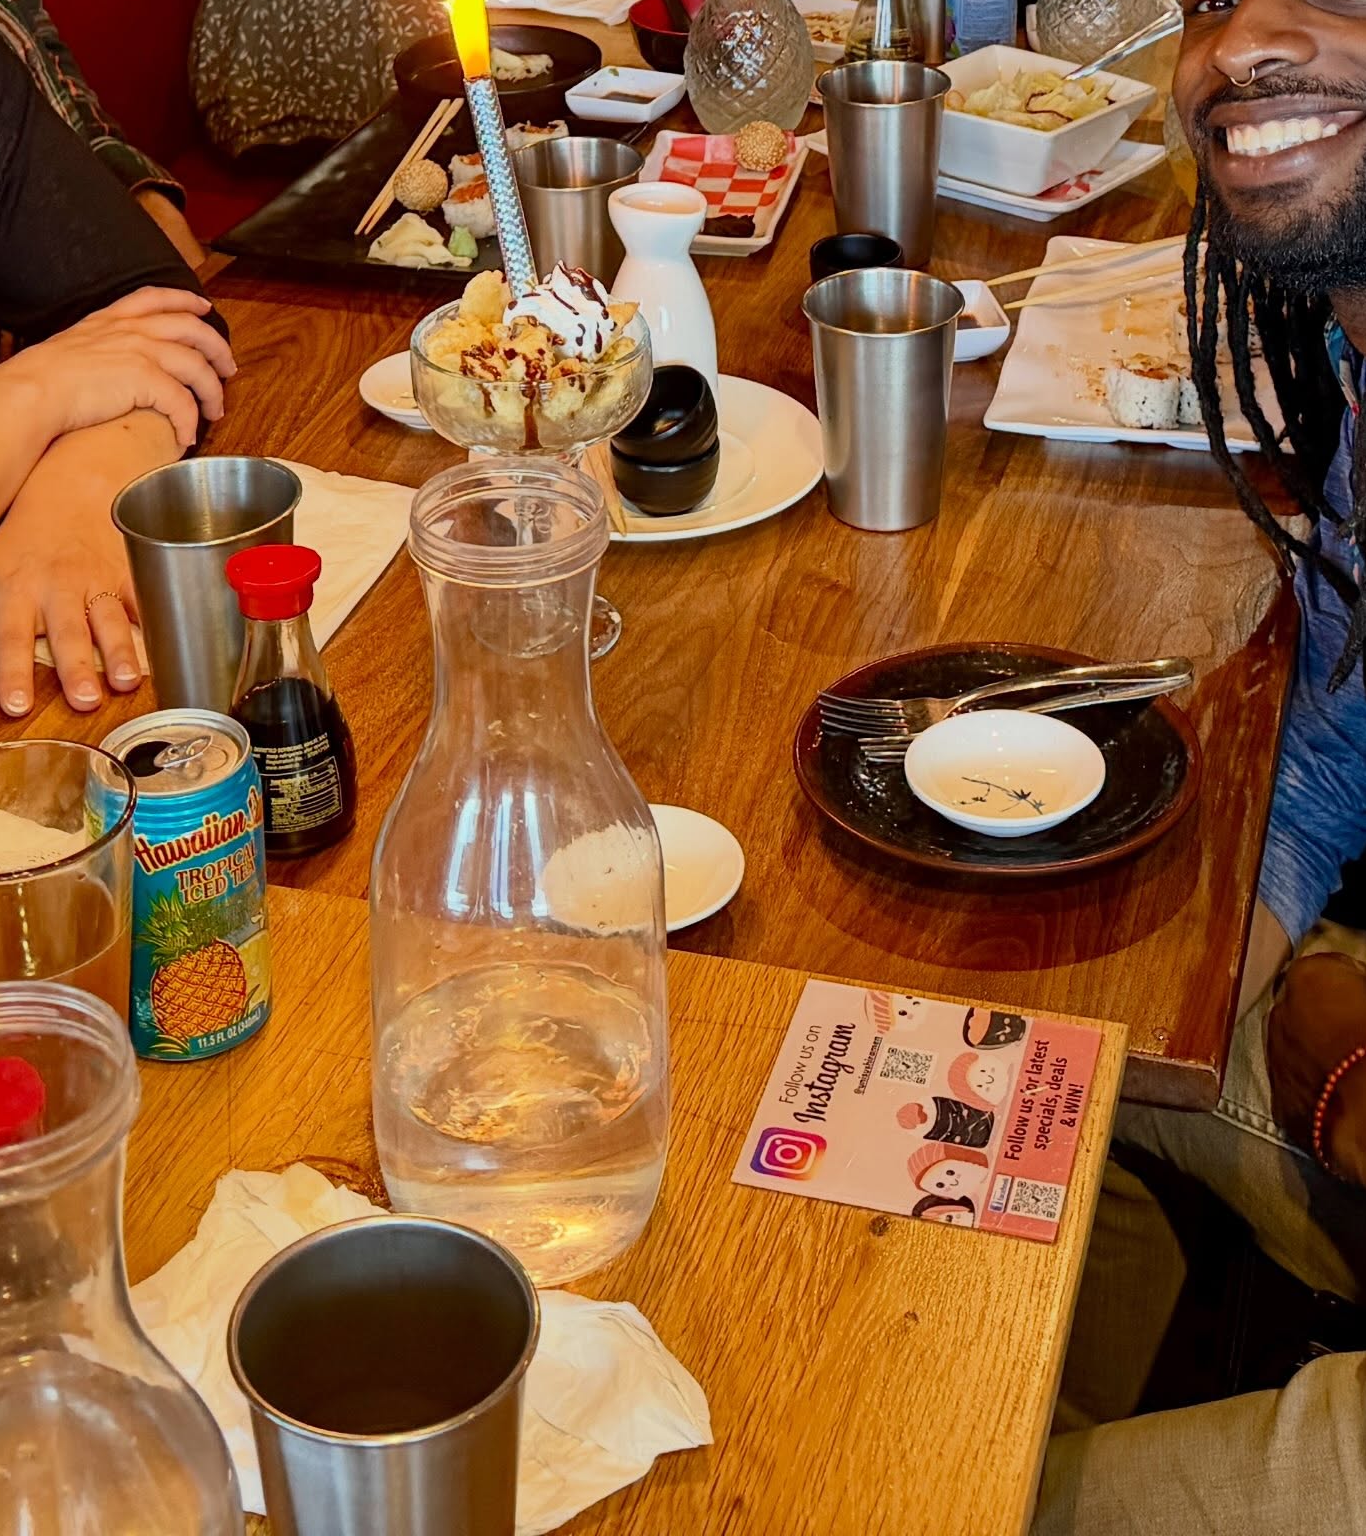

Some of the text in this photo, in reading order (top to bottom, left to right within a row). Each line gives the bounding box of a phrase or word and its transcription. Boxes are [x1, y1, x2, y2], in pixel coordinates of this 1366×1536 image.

[133, 808, 248, 875] Hawaiian
[181, 875, 228, 905] ICED
[196, 1034, 216, 1050] 11.5
[216, 1030, 227, 1044] FL
[227, 1026, 238, 1040] OZ
[778, 1024, 823, 1104] Follow us on
[793, 1022, 856, 1123] Instagram
[1003, 1116, 1031, 1161] Follow
[1021, 1097, 1035, 1114] us
[1029, 1039, 1051, 1076] latest
[1033, 1056, 1069, 1151] specials, deals
[1059, 1082, 1085, 1128] & WIN!
